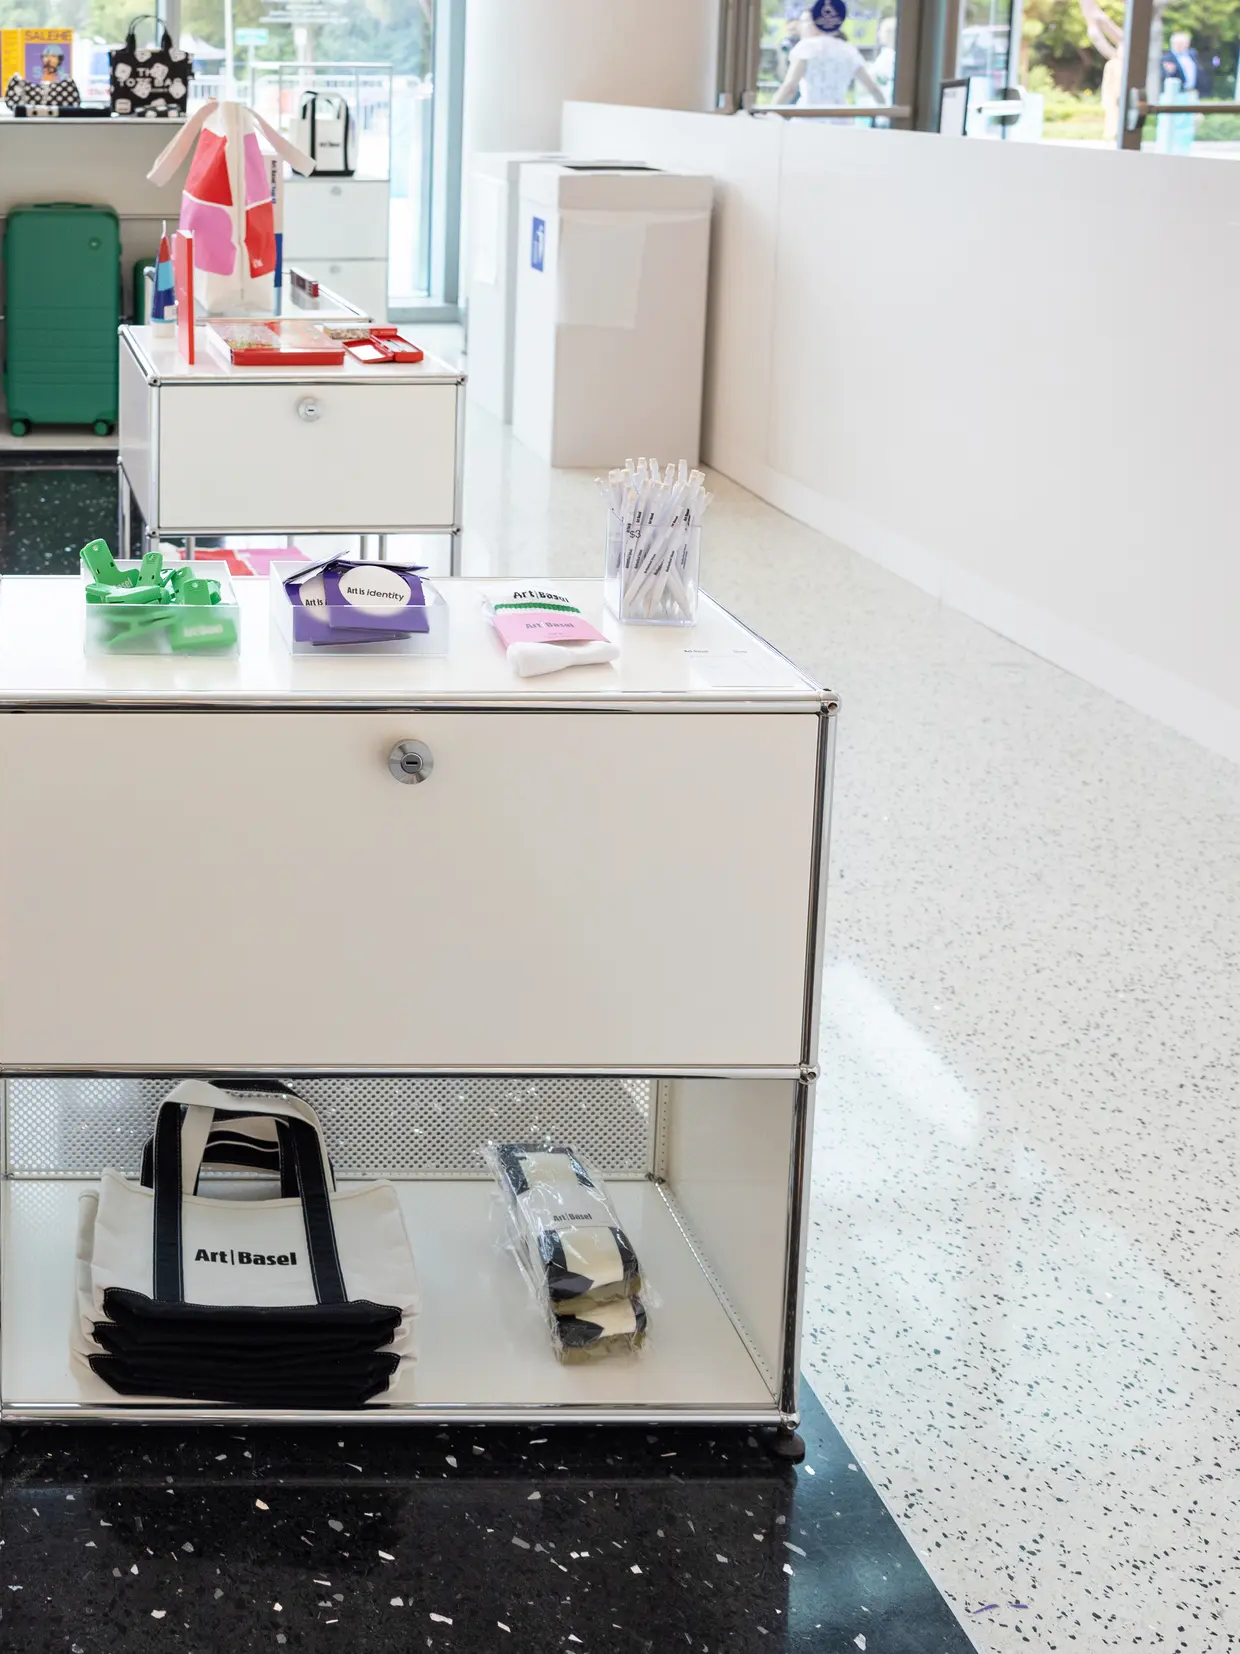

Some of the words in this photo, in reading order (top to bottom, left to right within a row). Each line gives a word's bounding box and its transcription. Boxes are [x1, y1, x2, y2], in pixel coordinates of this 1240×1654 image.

[347, 586, 359, 596] Art
[366, 589, 405, 602] identity
[513, 590, 535, 599] Art
[305, 598, 316, 606] Art
[568, 1212, 593, 1221] Basel
[194, 1249, 229, 1264] Art
[238, 1251, 298, 1266] Basel
